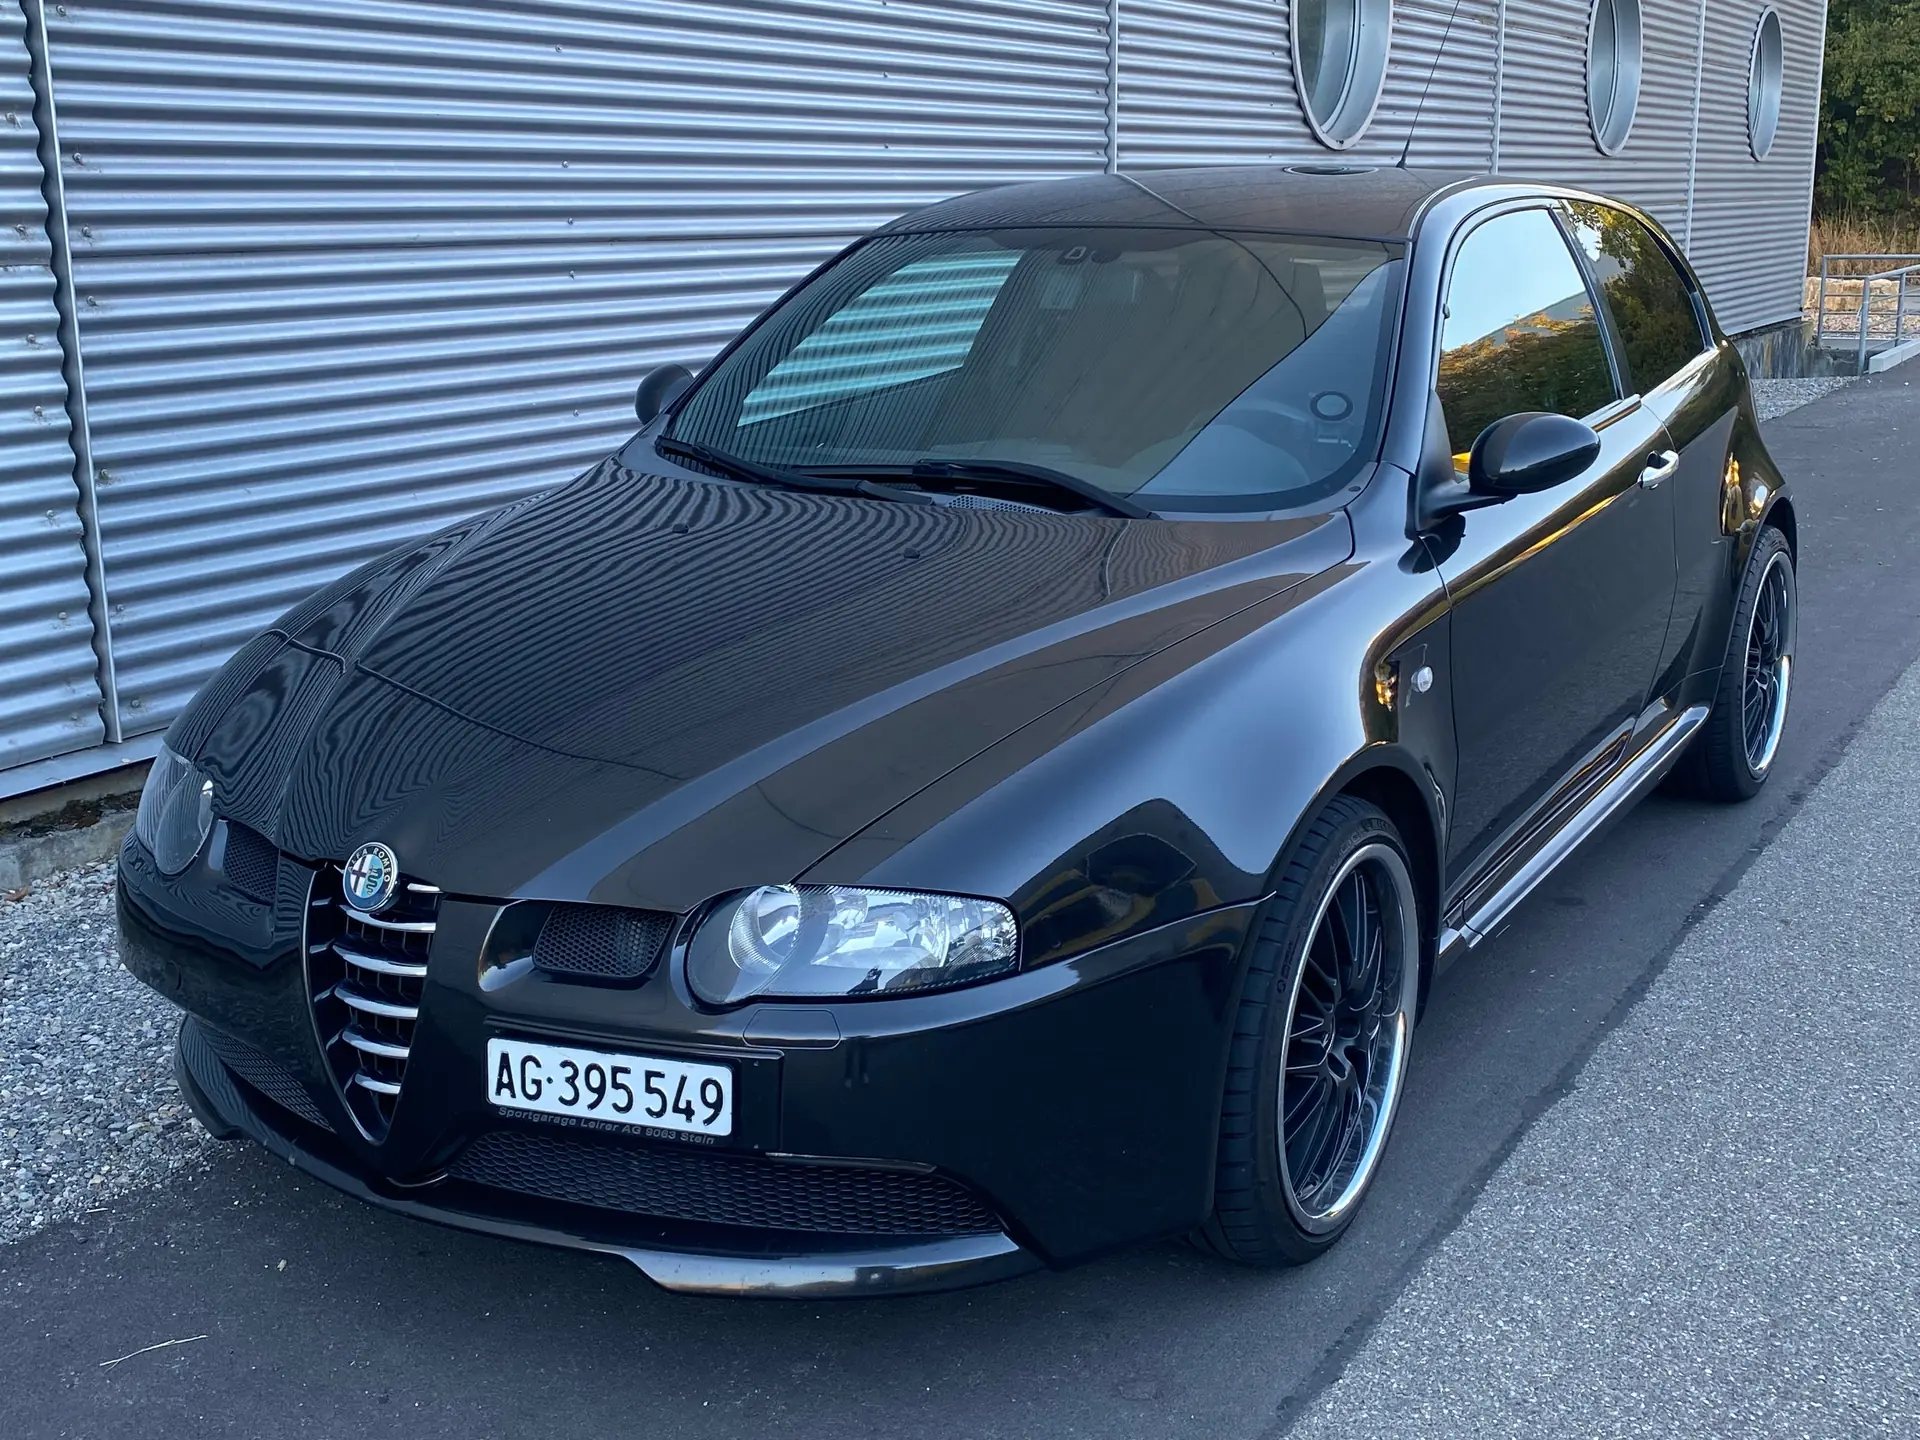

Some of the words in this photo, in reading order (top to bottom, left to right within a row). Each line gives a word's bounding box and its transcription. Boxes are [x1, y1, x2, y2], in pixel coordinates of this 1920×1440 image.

[348, 848, 368, 873] ALFA
[372, 847, 391, 882] ROMEO
[499, 1106, 577, 1127] Sportgarage
[621, 1124, 642, 1135] AG
[645, 1127, 676, 1140] 9063
[680, 1132, 715, 1145] Stein
